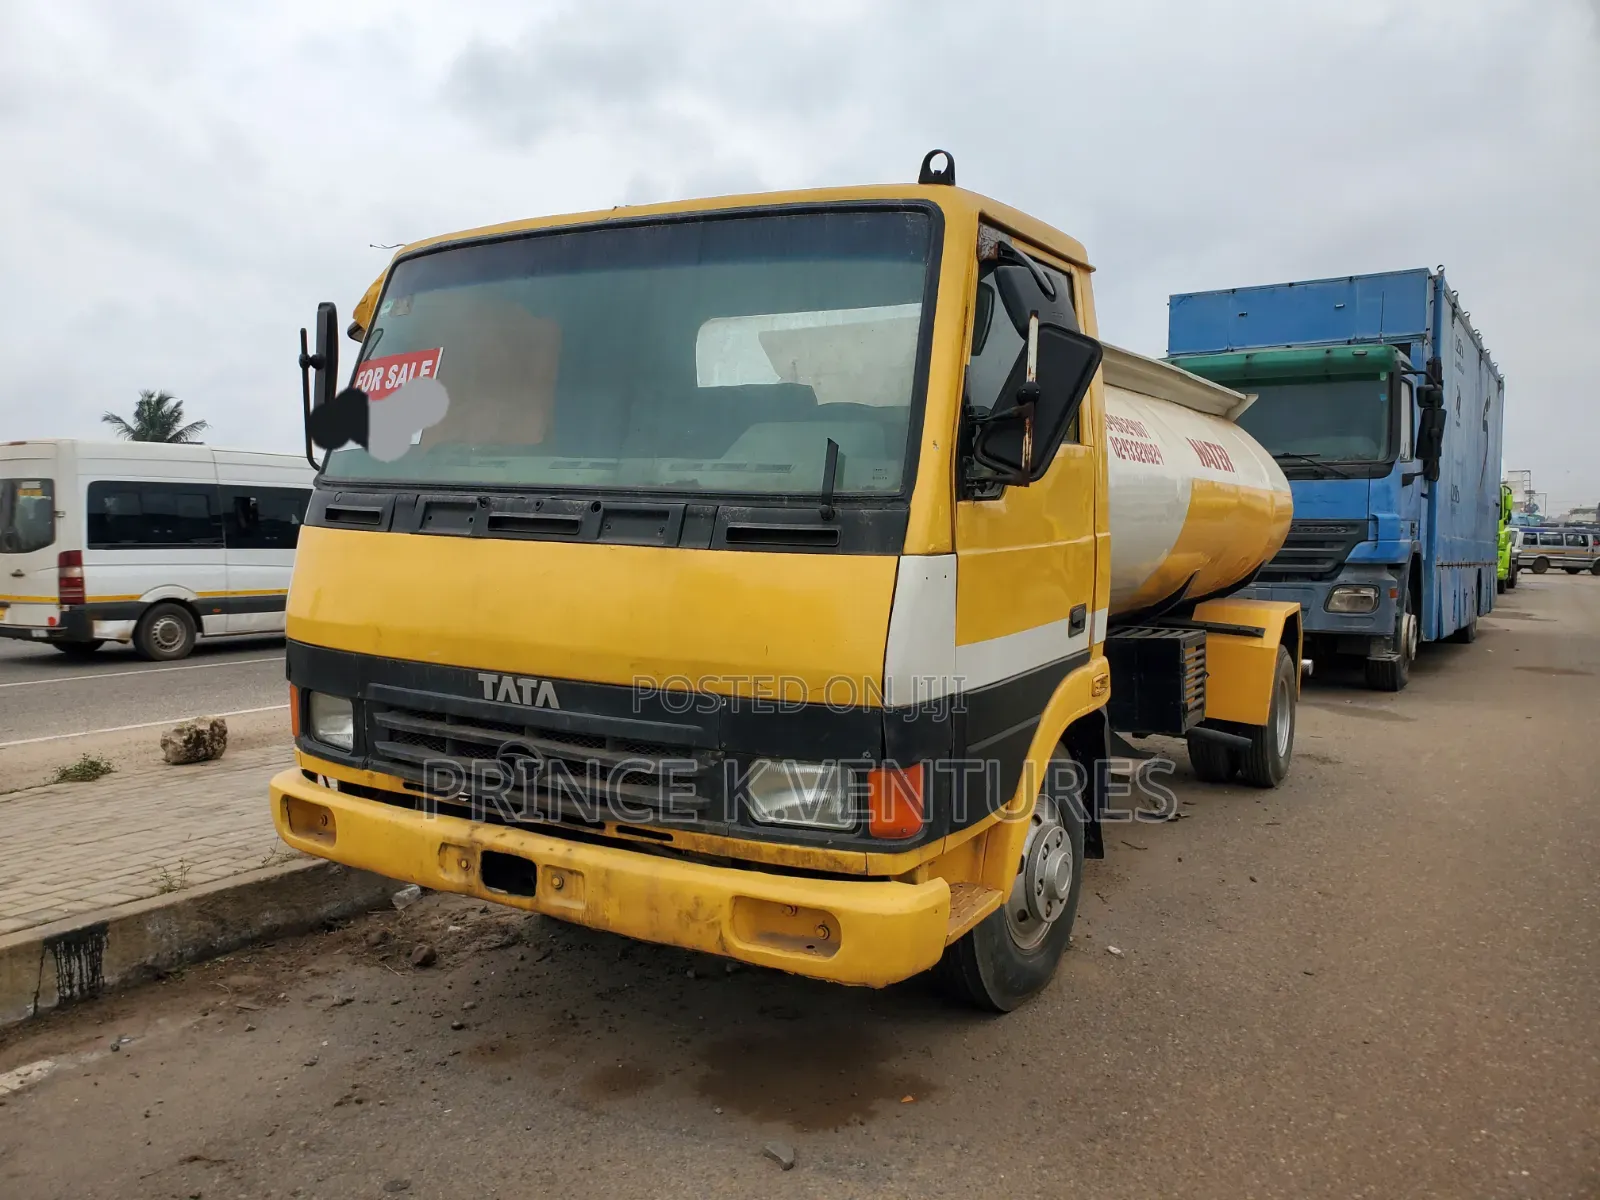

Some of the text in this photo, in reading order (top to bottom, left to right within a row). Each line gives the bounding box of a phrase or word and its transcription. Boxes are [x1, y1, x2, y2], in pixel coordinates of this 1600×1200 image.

[355, 366, 385, 393] FOR
[1185, 436, 1236, 473] WATER
[477, 672, 561, 710] TATA
